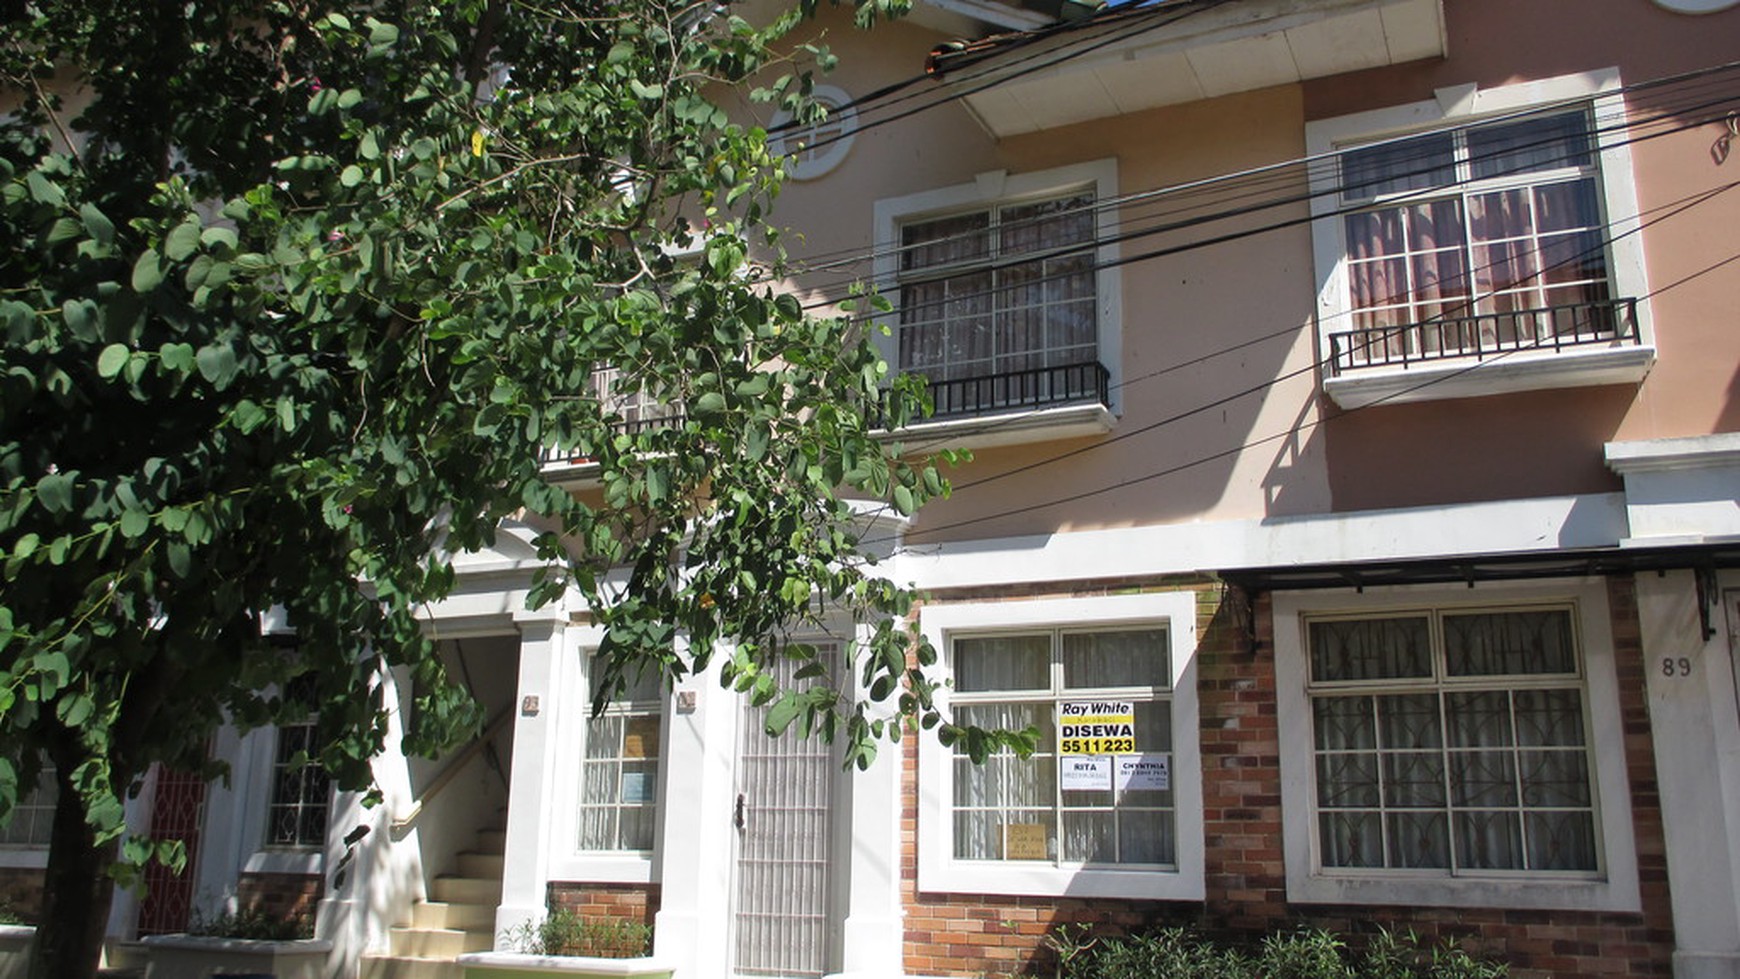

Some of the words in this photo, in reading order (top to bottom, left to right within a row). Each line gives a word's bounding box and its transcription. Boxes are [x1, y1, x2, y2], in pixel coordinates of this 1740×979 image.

[1663, 657, 1691, 677] 89
[1062, 703, 1088, 716] Ray
[1091, 703, 1129, 714] White
[1062, 725, 1132, 737] DISEWA
[1074, 763, 1097, 771] RITA
